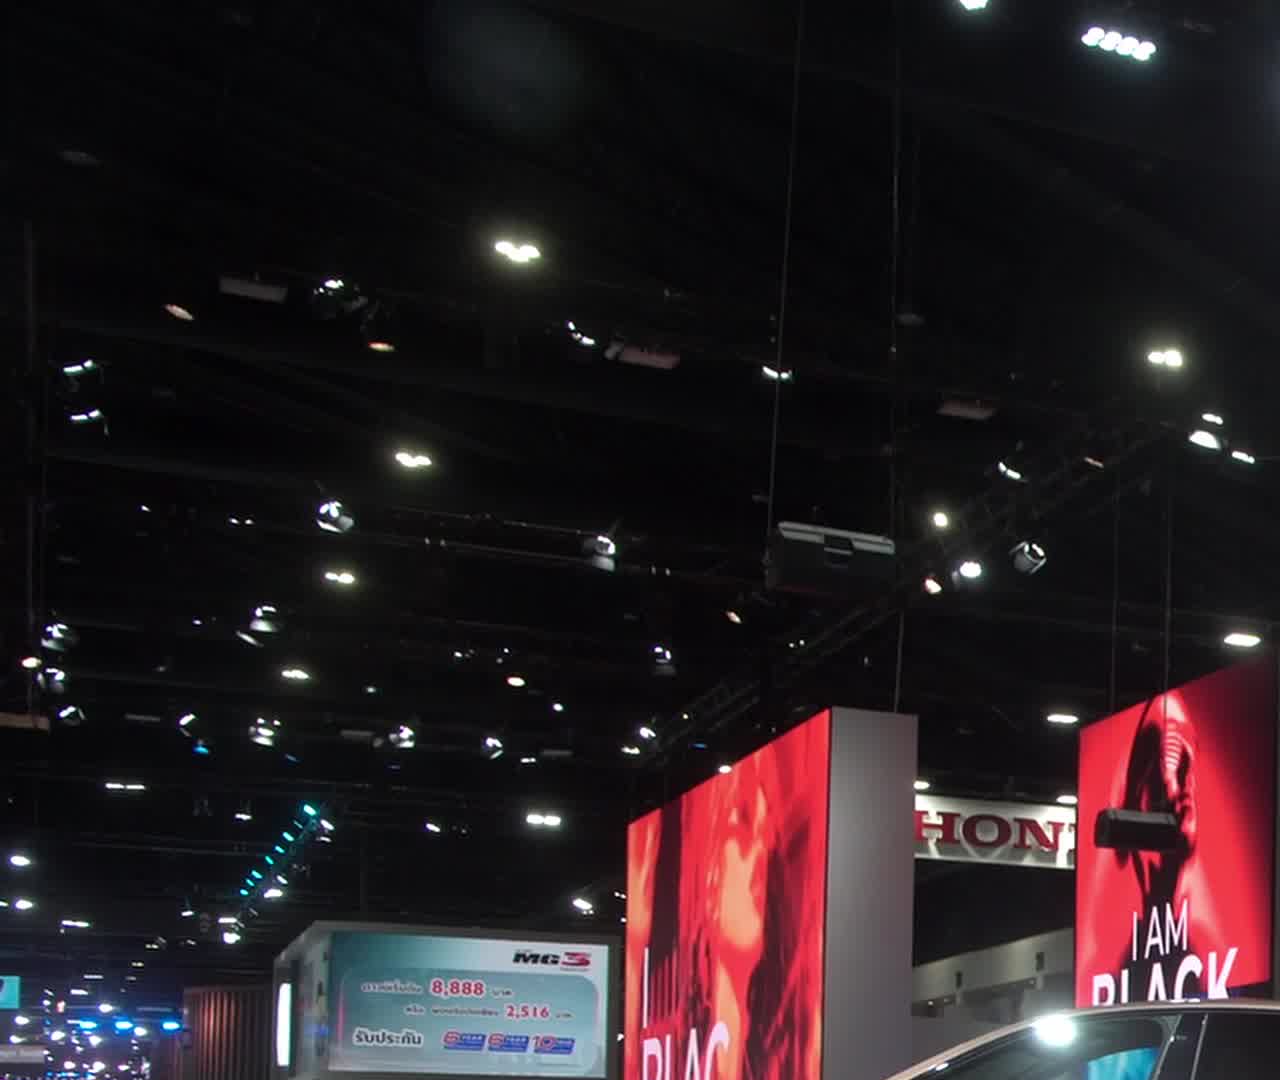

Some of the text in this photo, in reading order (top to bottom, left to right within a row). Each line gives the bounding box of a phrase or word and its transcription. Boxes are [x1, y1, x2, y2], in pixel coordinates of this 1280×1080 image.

[914, 810, 1075, 851] HON
[1144, 899, 1188, 959] AM
[430, 979, 485, 997] 8,888
[506, 1004, 550, 1021] 2,516
[353, 1028, 422, 1046] รับประกัน
